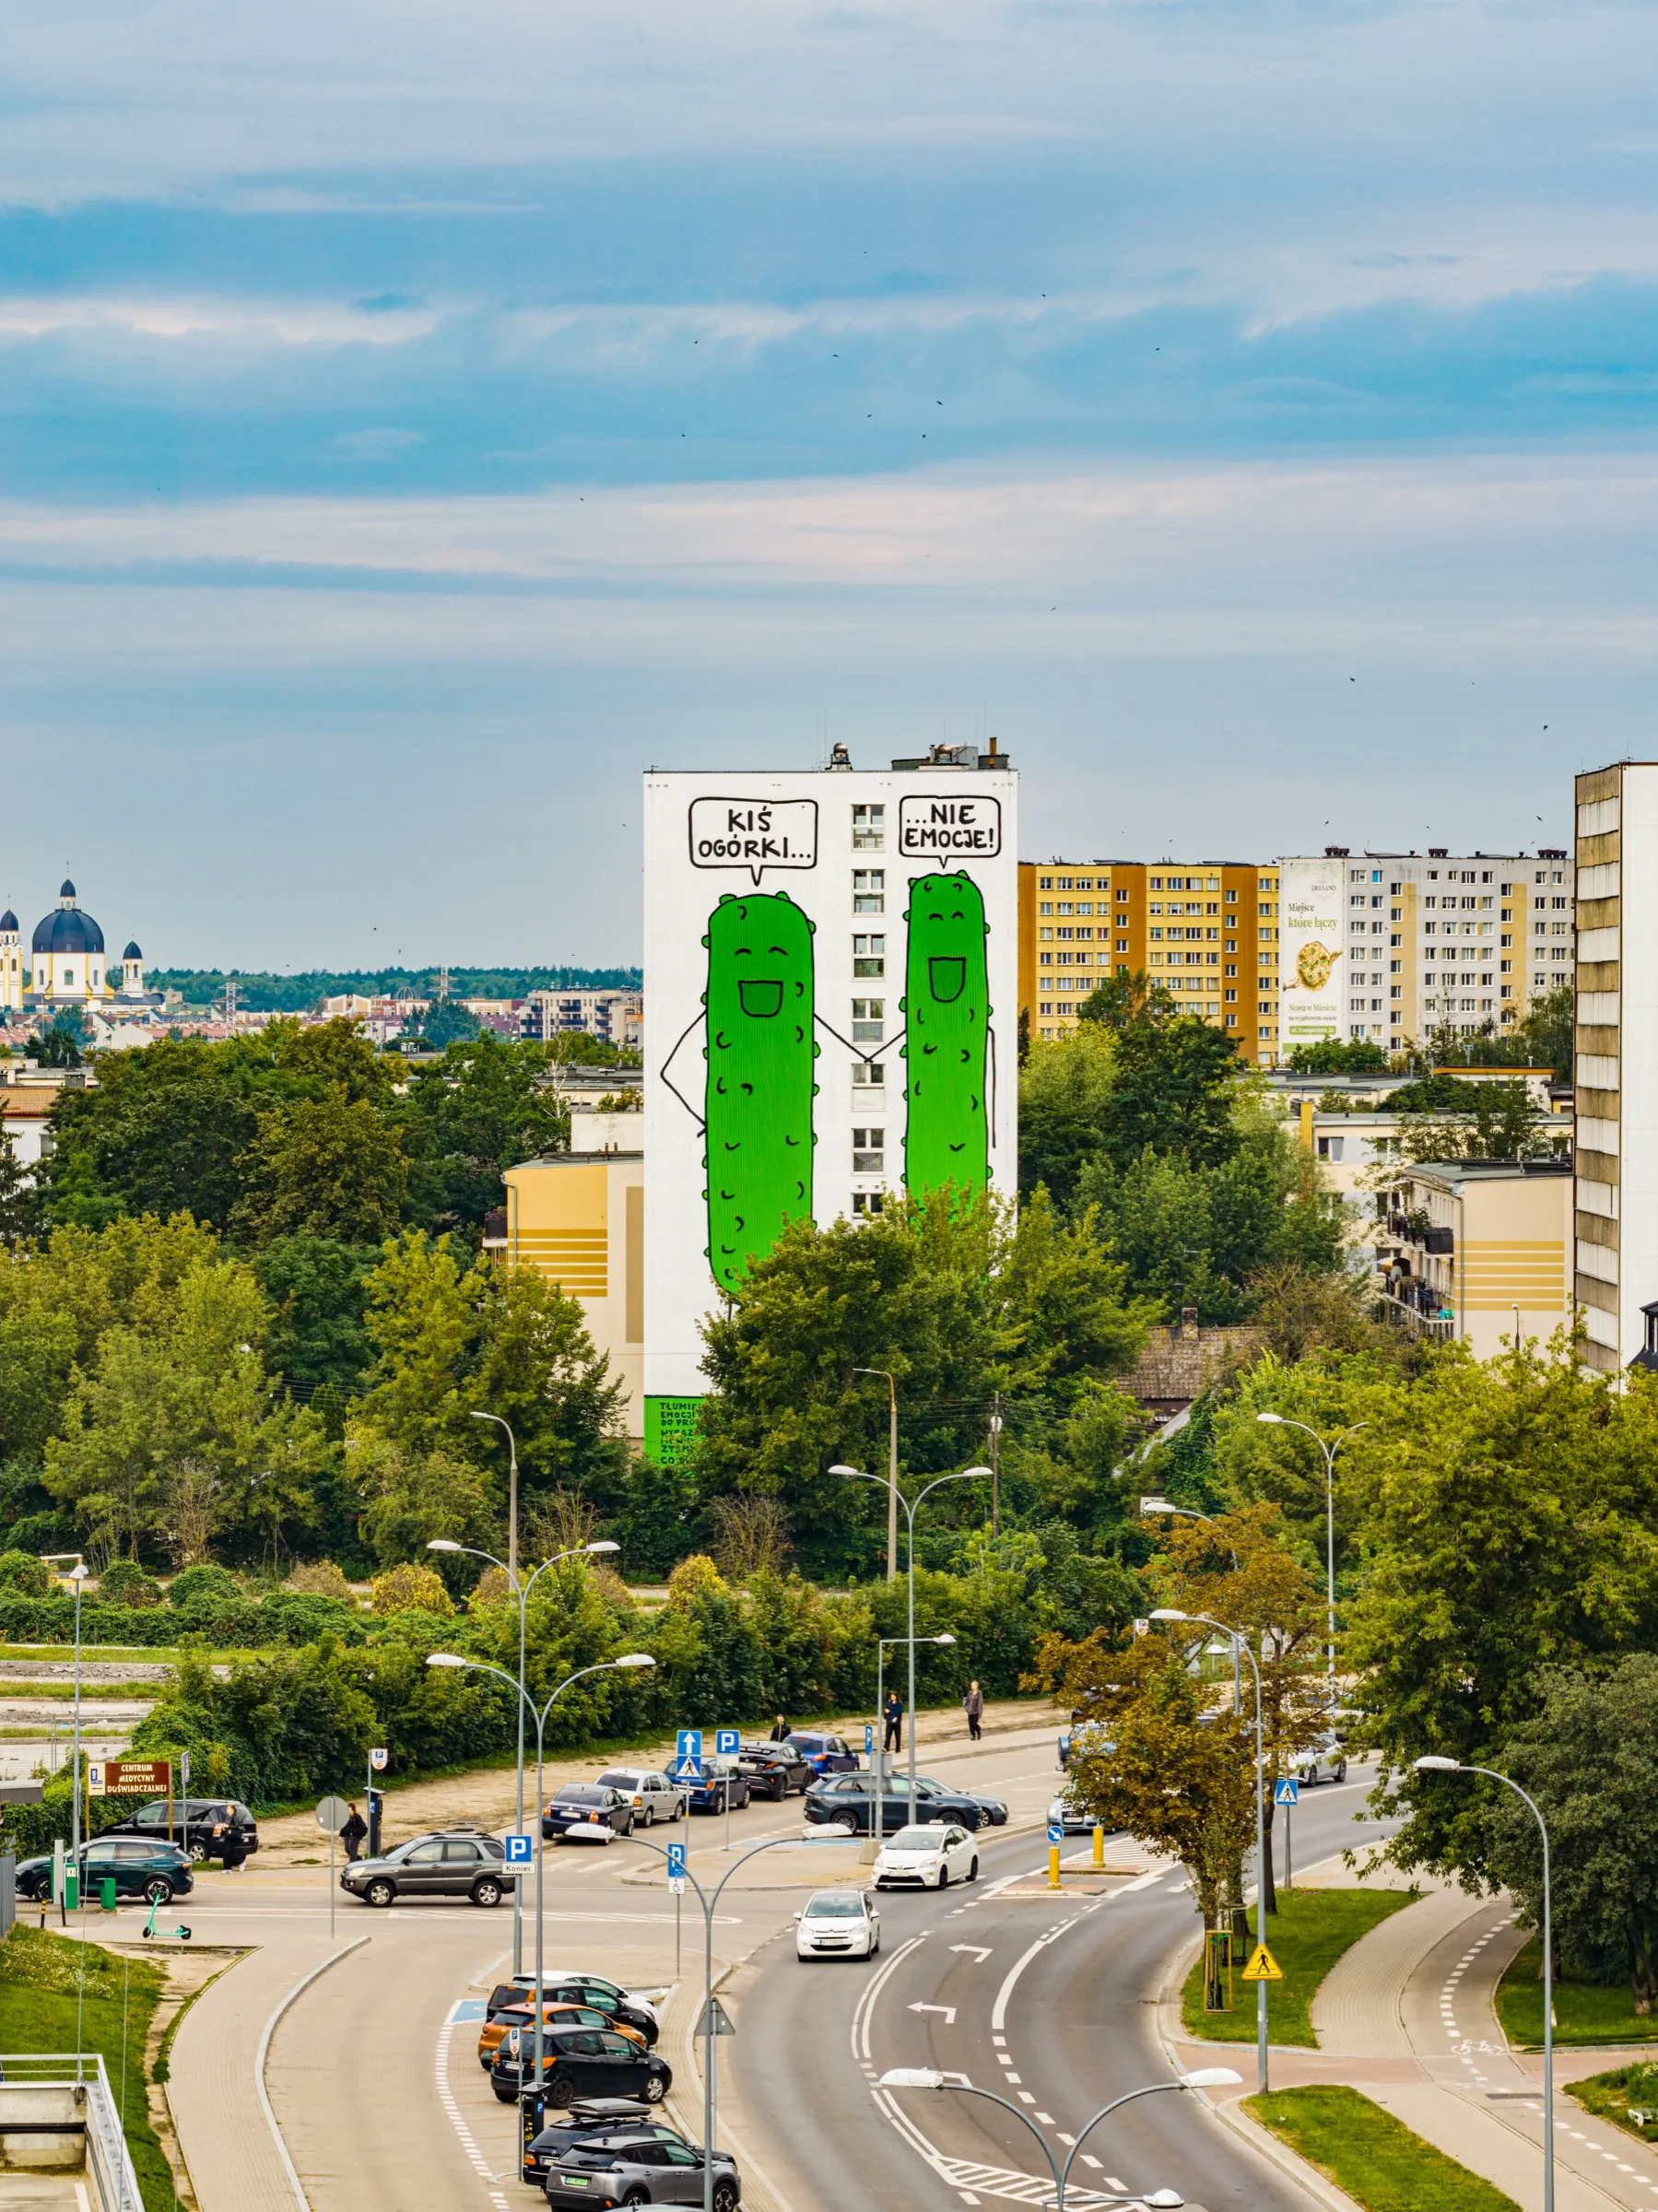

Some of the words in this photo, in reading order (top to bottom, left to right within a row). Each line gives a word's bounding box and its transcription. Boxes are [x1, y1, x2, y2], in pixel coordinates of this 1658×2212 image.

[728, 806, 771, 832] KIŚ
[906, 804, 976, 825] ...NIE
[699, 833, 811, 858] OGÓRKI...
[905, 828, 994, 849] EMOCJE!
[1288, 902, 1315, 913] Miejsce
[1288, 915, 1313, 928] które
[1314, 916, 1338, 930] łączy
[721, 1733, 735, 1751] P
[107, 1783, 167, 1793] DOŚWIADCZALNEJ
[119, 1774, 155, 1783] MEDYCYNY
[511, 1839, 526, 1860] P
[672, 1847, 682, 1867] P
[538, 2103, 543, 2112] P
